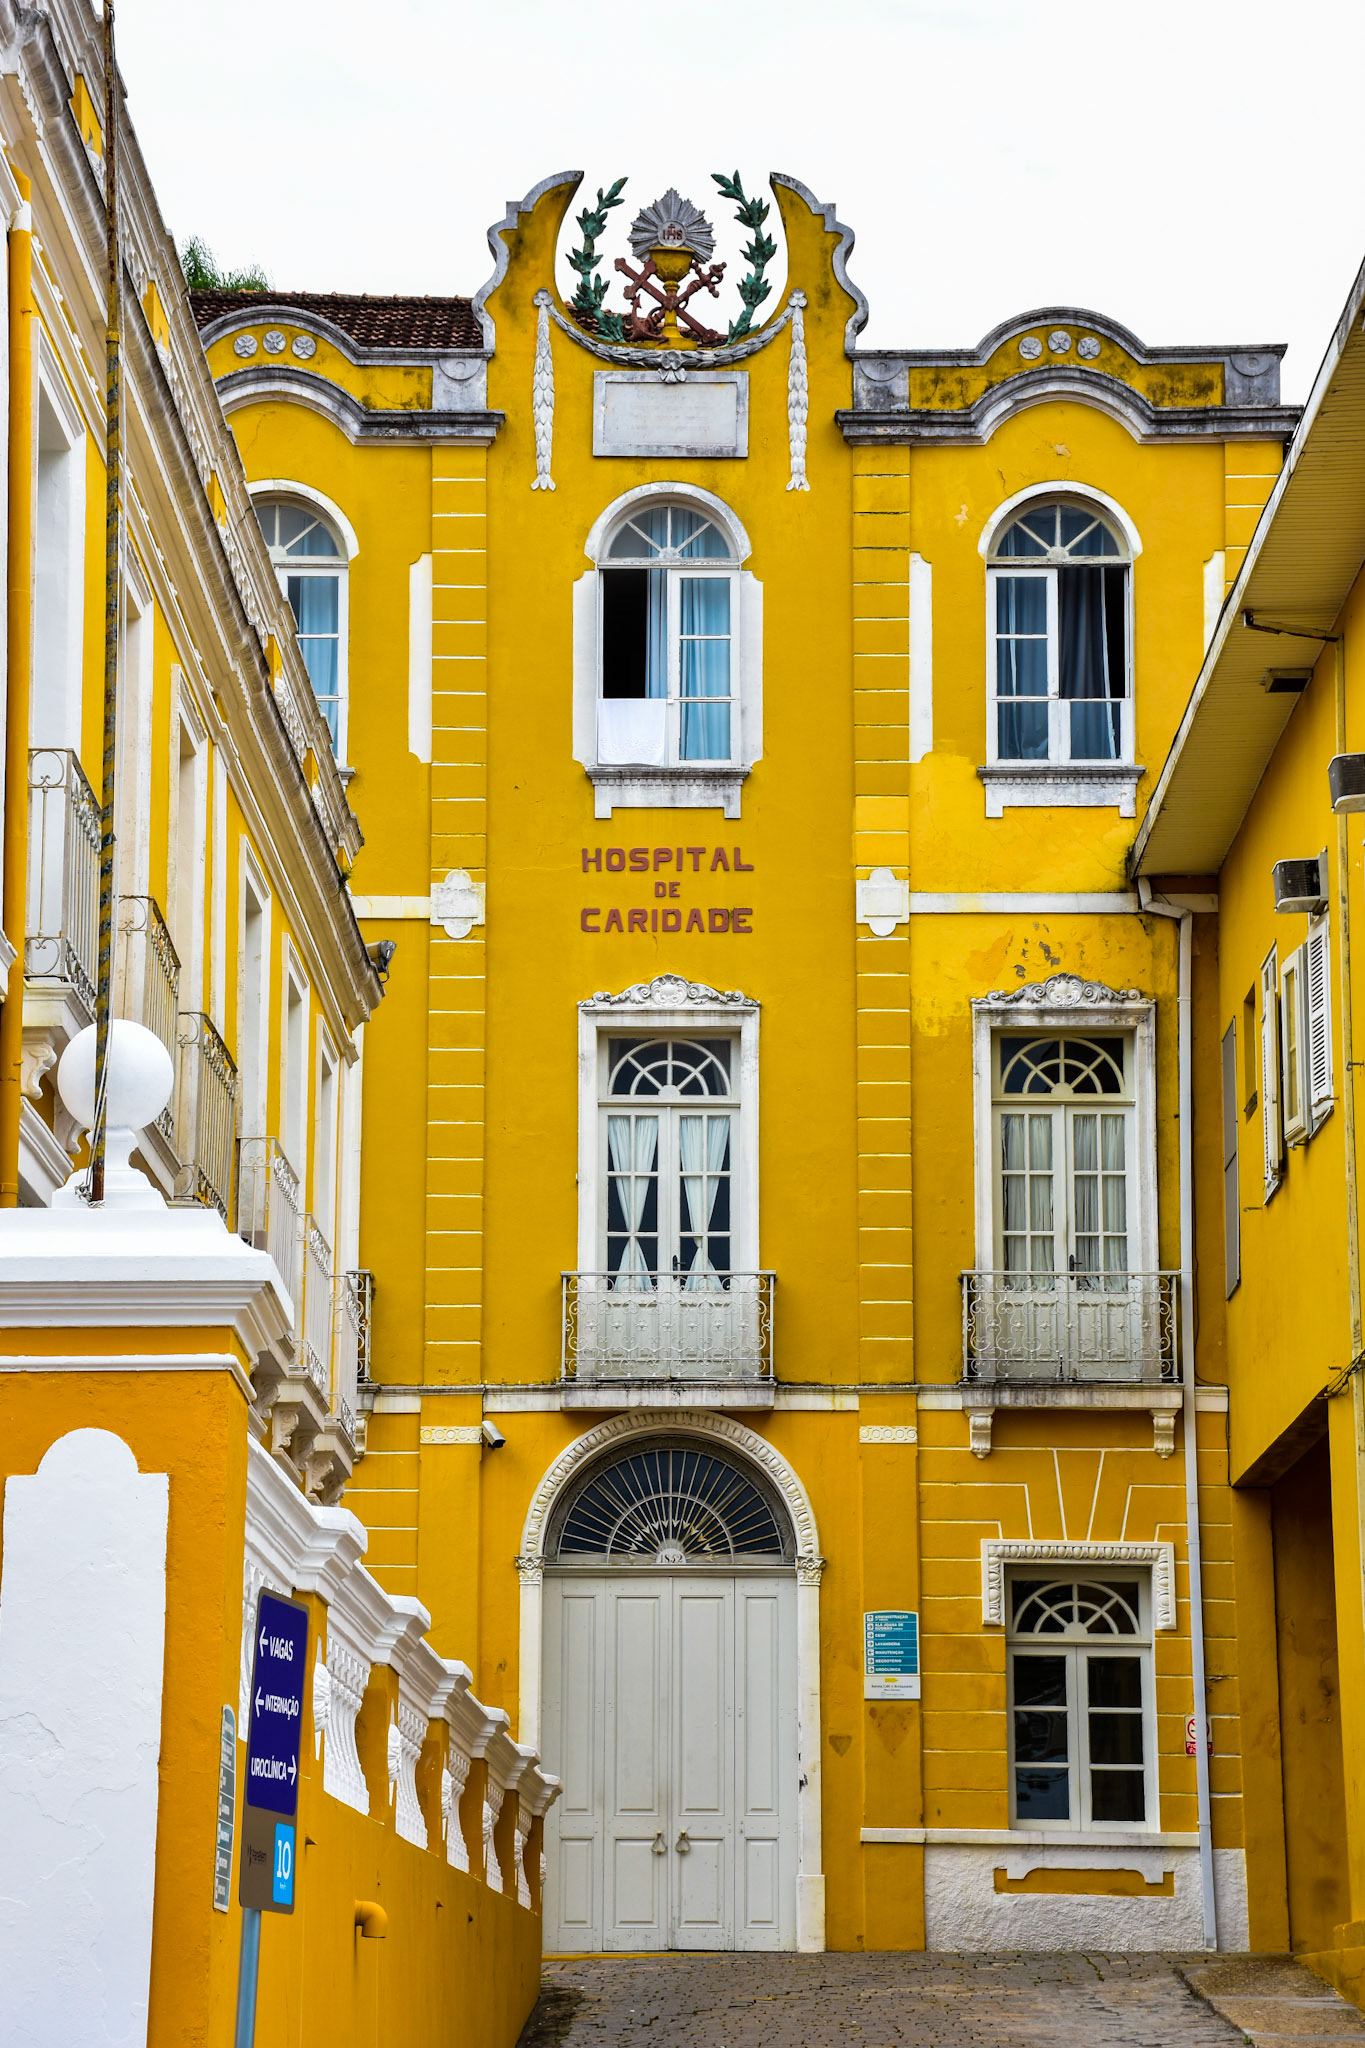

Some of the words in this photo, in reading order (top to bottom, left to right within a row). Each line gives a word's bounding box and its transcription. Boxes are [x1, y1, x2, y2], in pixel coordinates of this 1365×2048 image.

[581, 847, 754, 872] HOSPITAL
[654, 881, 681, 897] DE
[580, 907, 753, 933] CARIDADE
[269, 1635, 294, 1662] VAGAS
[264, 1694, 300, 1721] INTERNAÇÃO
[251, 1755, 287, 1780] UROCLÍNICA
[277, 1840, 291, 1880] 10
